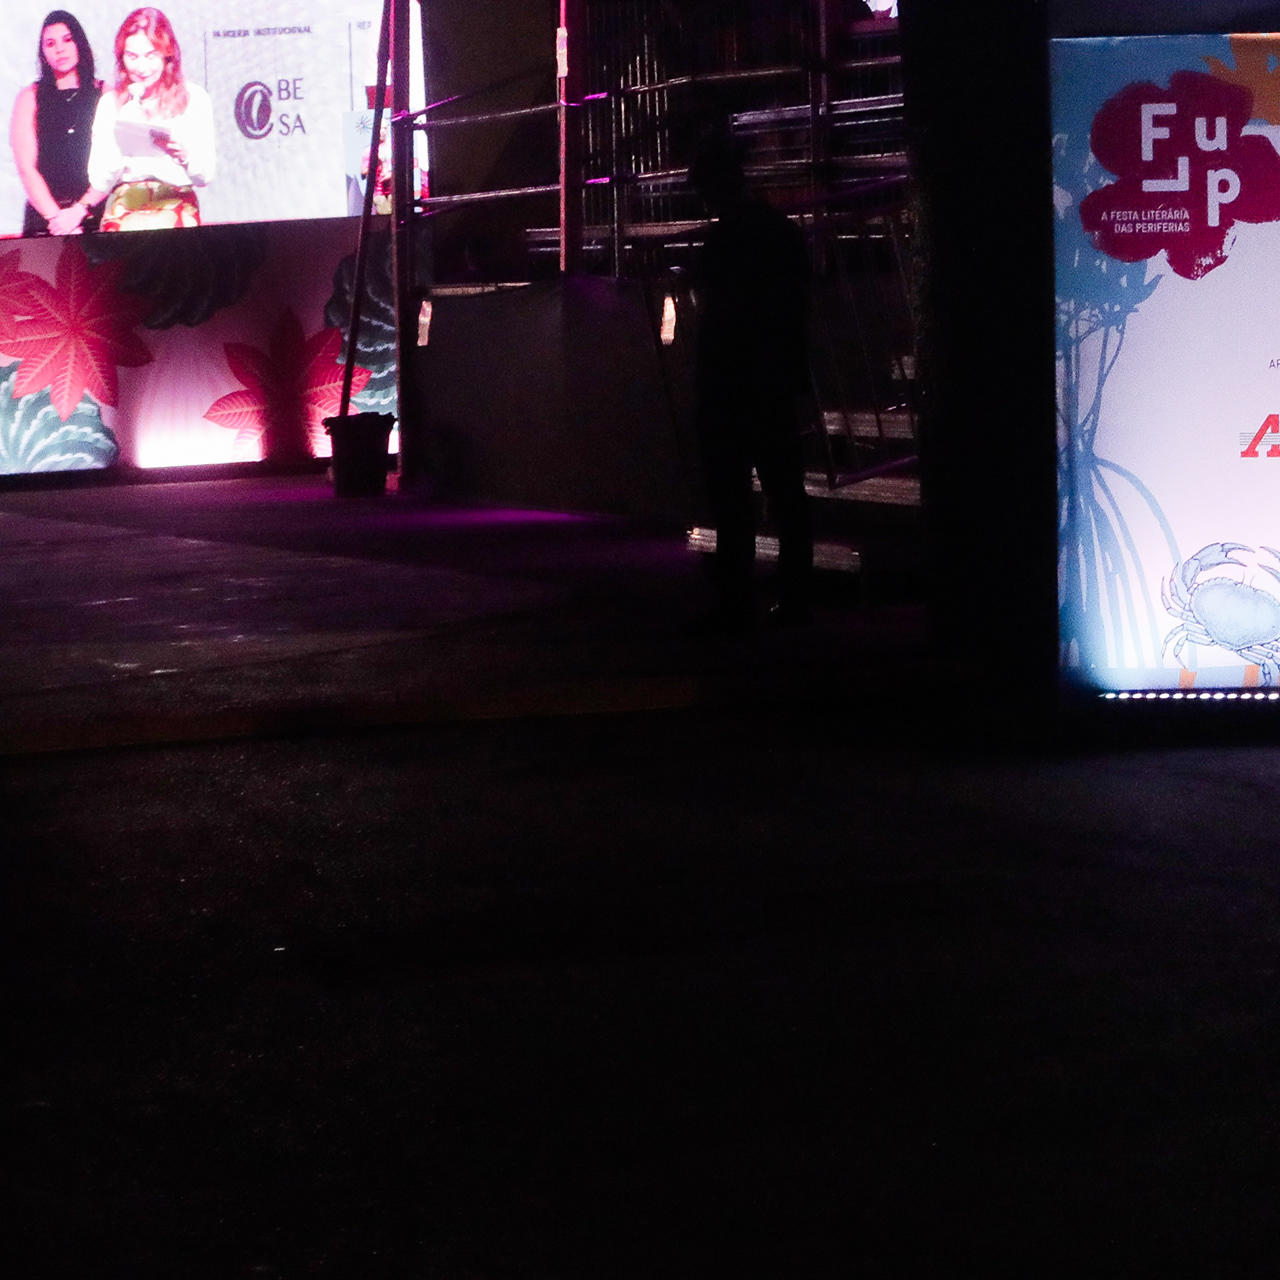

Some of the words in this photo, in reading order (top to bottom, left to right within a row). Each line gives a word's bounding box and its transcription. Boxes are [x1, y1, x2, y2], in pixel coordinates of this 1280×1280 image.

[1101, 211, 1108, 221] A
[1110, 210, 1139, 221] FESTA
[1114, 224, 1133, 234] DAS
[1135, 222, 1190, 233] PERIFERIAS
